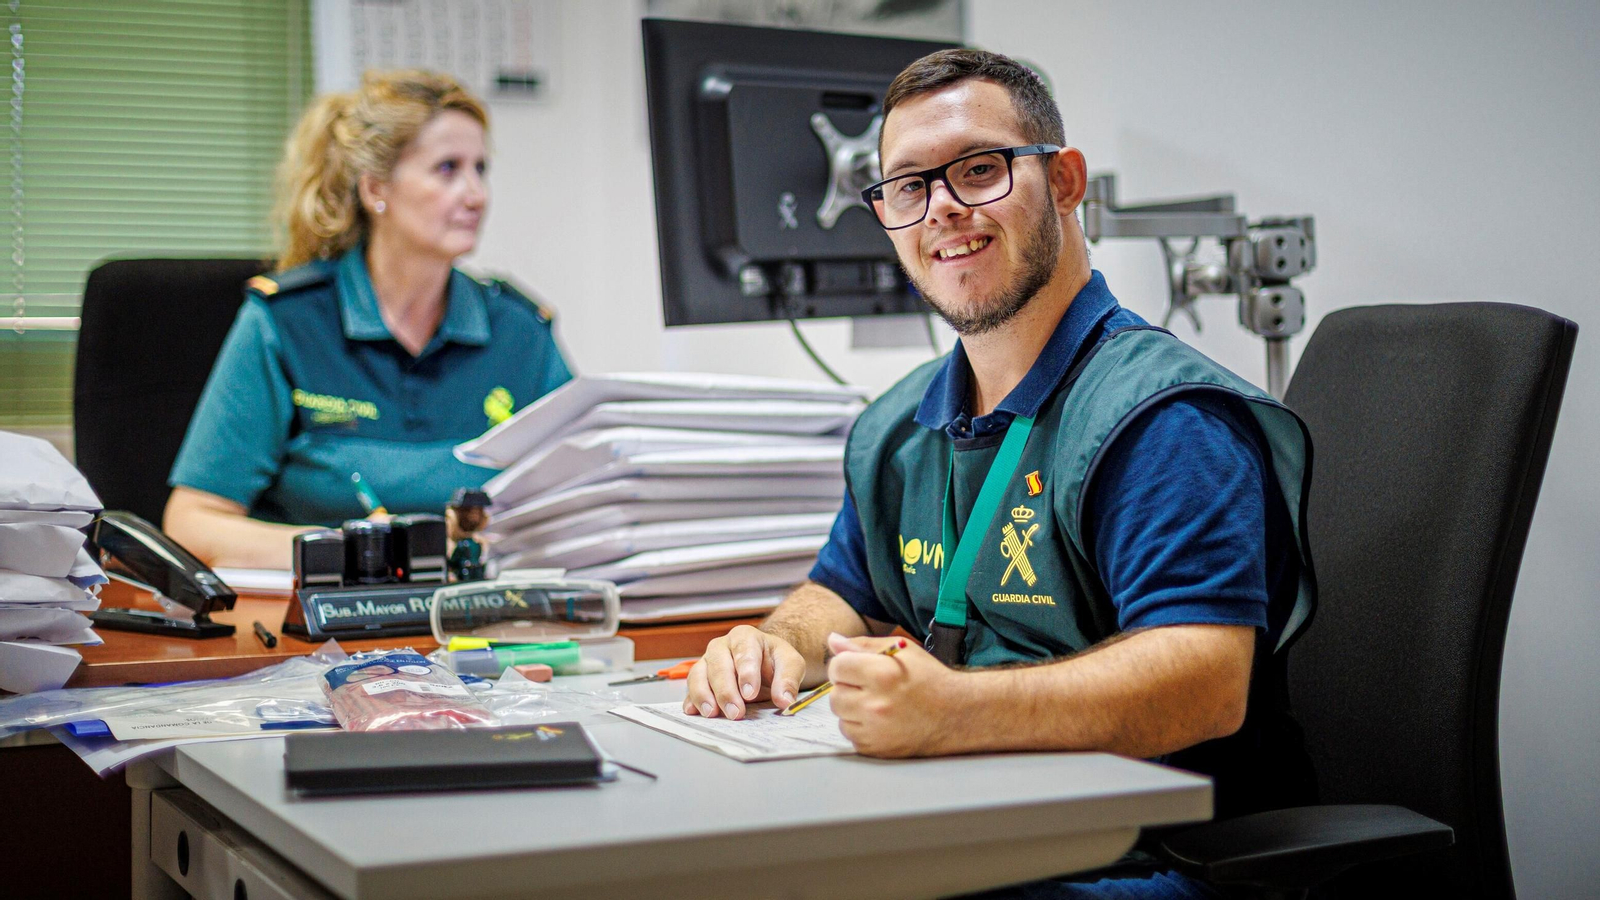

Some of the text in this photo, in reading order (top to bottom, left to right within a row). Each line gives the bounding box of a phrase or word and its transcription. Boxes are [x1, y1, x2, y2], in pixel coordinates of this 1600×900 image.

[899, 534, 944, 569] OWN
[992, 593, 1056, 605] GUARDIA CIVIL
